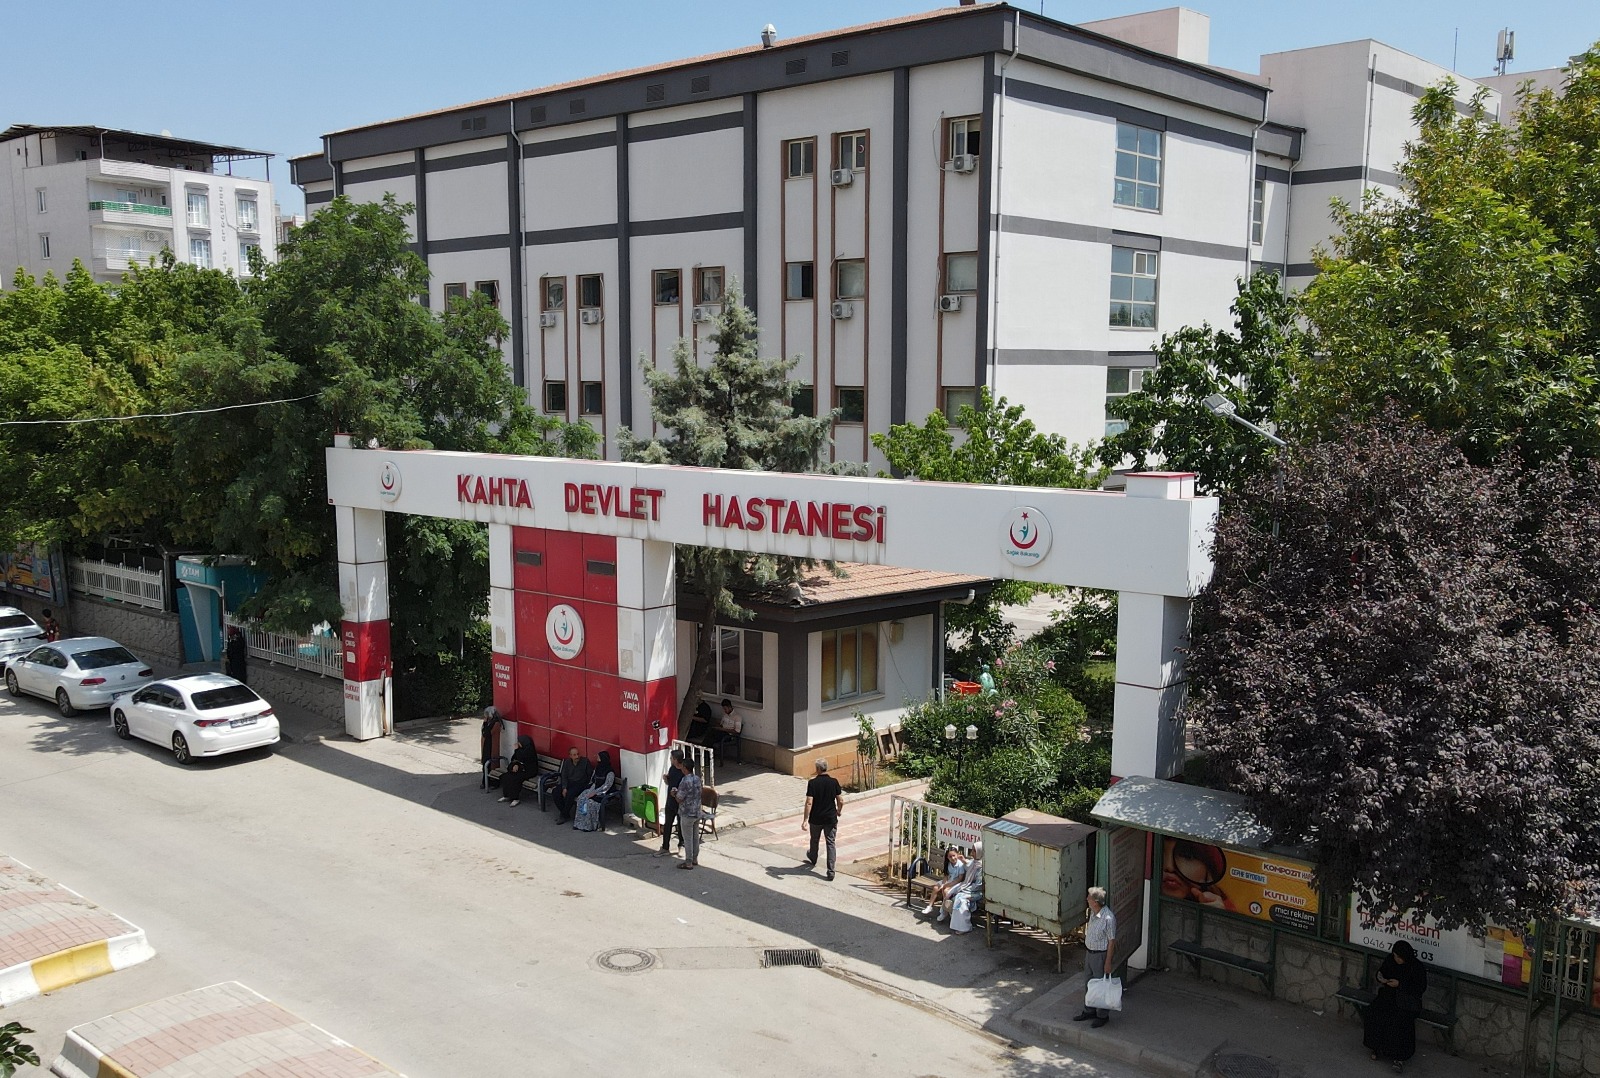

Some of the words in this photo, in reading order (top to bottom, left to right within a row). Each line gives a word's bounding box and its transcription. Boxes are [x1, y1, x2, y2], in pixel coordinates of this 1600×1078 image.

[457, 473, 534, 508] KAHTA
[564, 482, 665, 521] DEVLET
[623, 691, 639, 701] YAYA
[622, 701, 640, 712] GİRİŞİ
[950, 816, 963, 827] OTO
[964, 819, 982, 832] PARK
[939, 827, 952, 837] YAN
[1264, 890, 1289, 901] KUTU
[1290, 910, 1315, 922] reklam
[1363, 936, 1385, 948] 0416
[1421, 951, 1434, 961] 03
